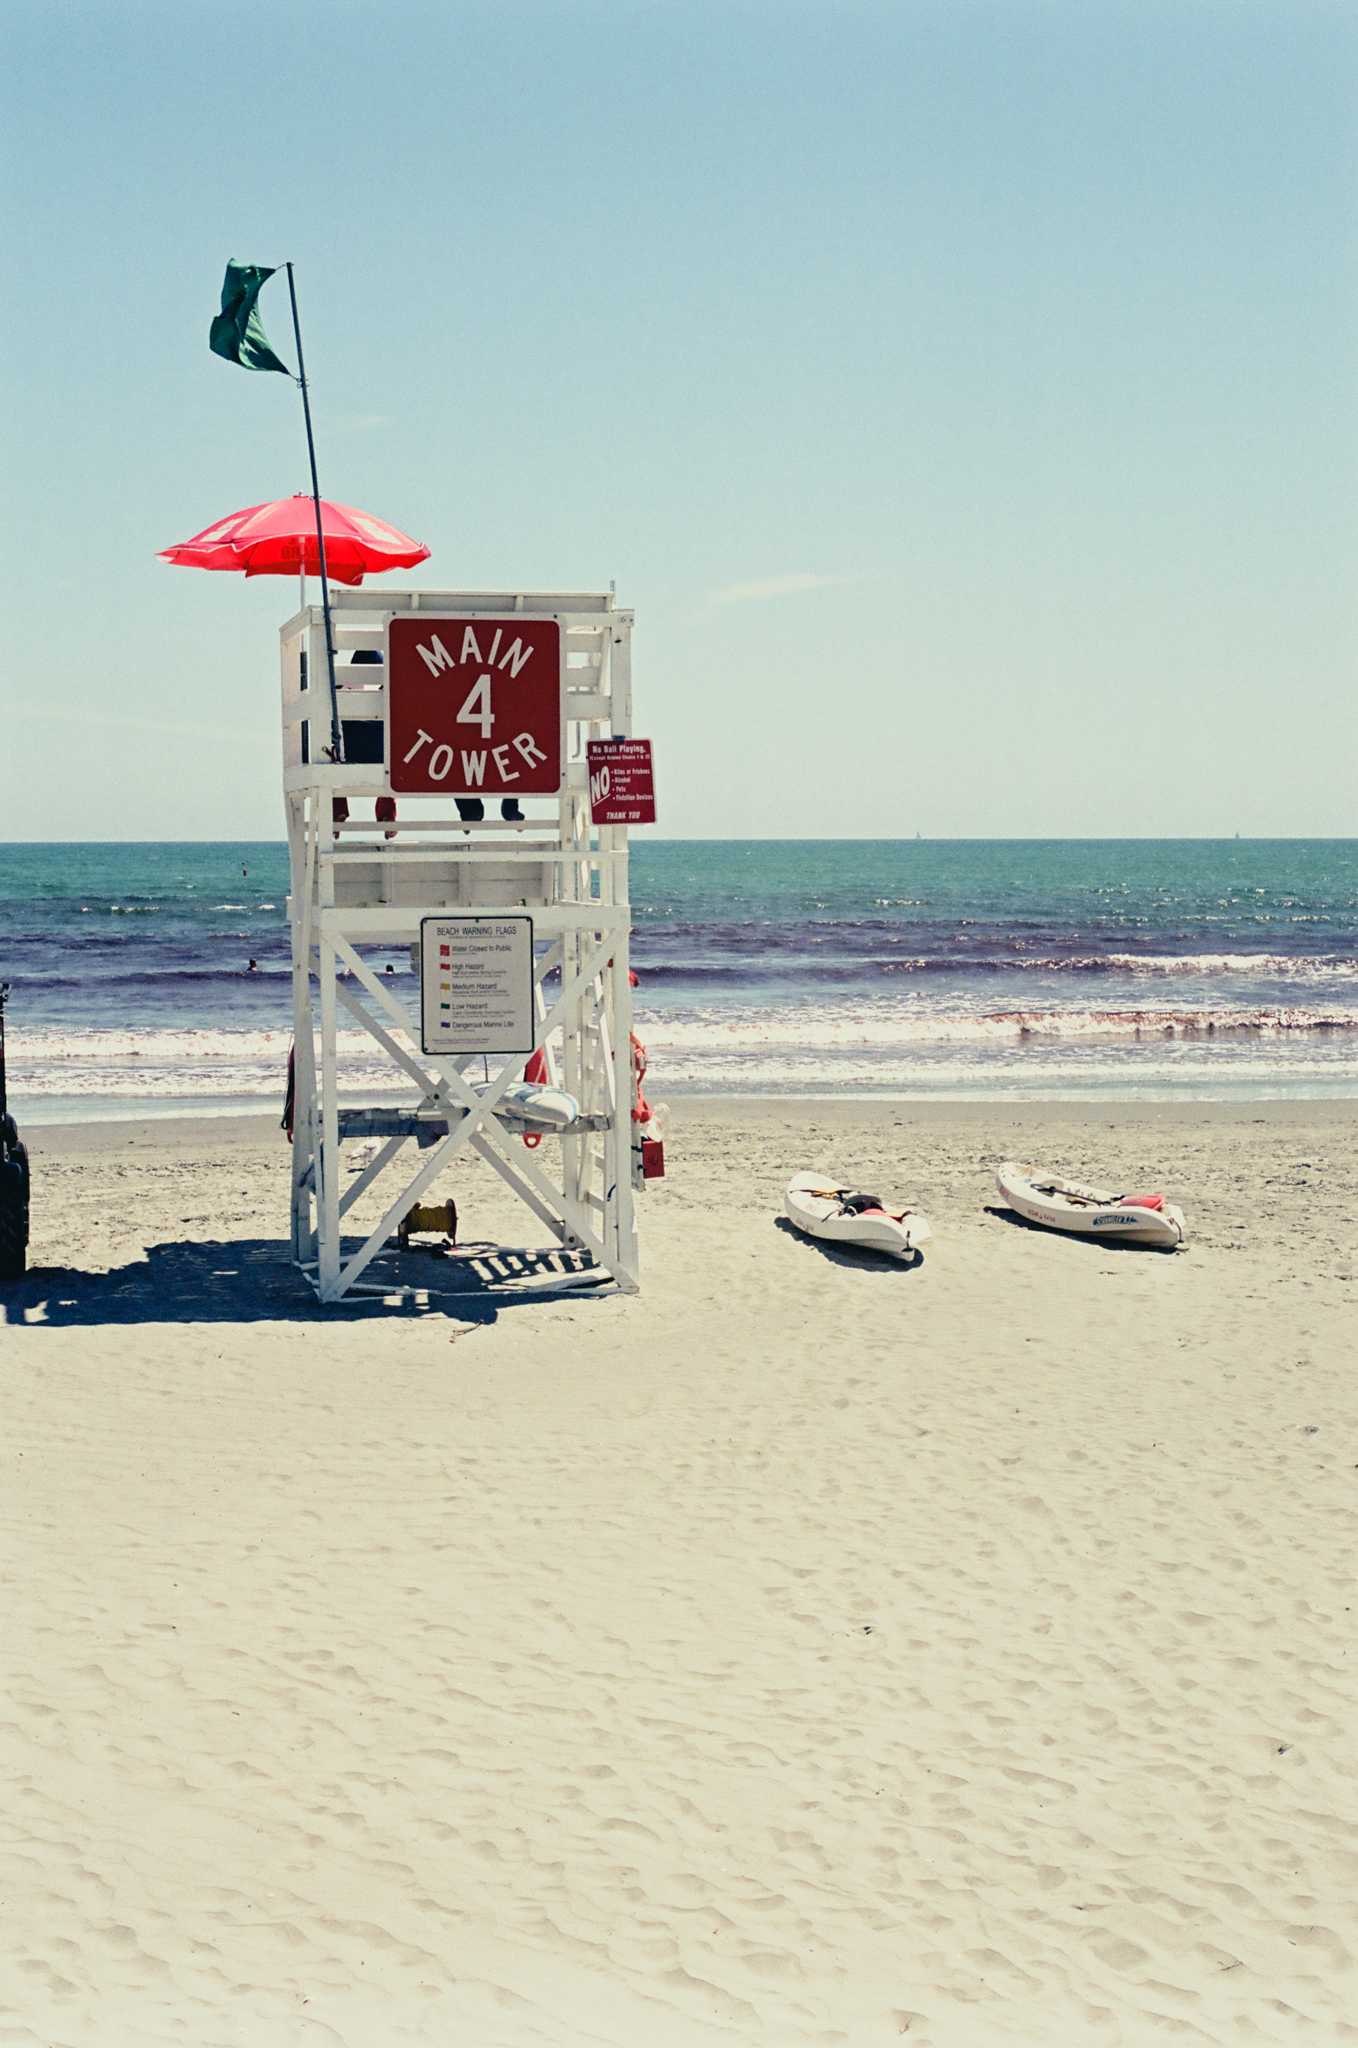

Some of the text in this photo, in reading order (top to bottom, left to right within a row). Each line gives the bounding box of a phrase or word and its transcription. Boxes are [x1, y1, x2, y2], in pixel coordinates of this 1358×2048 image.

[415, 626, 534, 679] MAIN
[456, 674, 495, 739] 4
[402, 729, 547, 786] TOWER
[592, 745, 601, 753] No
[603, 745, 617, 753] Ball
[590, 765, 610, 804] NO
[629, 811, 640, 819] YOU
[437, 925, 517, 936] BEACH WARNING FLAGS
[452, 1021, 482, 1029] Dangerous
